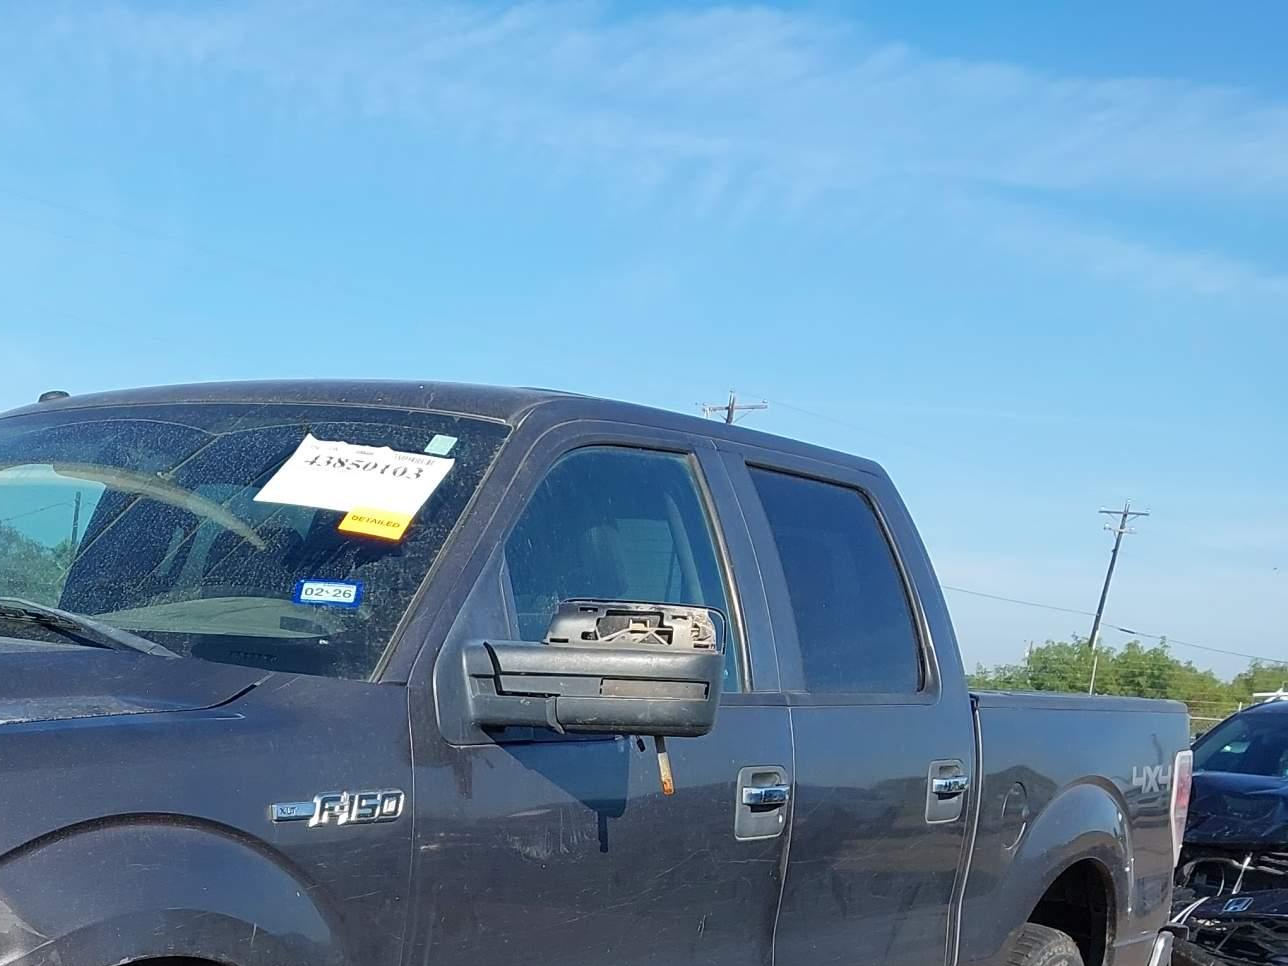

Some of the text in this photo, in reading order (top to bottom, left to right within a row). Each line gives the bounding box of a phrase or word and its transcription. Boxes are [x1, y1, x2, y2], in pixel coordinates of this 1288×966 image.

[304, 455, 424, 481] 43850103
[351, 515, 401, 528] DETAILED
[279, 807, 297, 815] XLT
